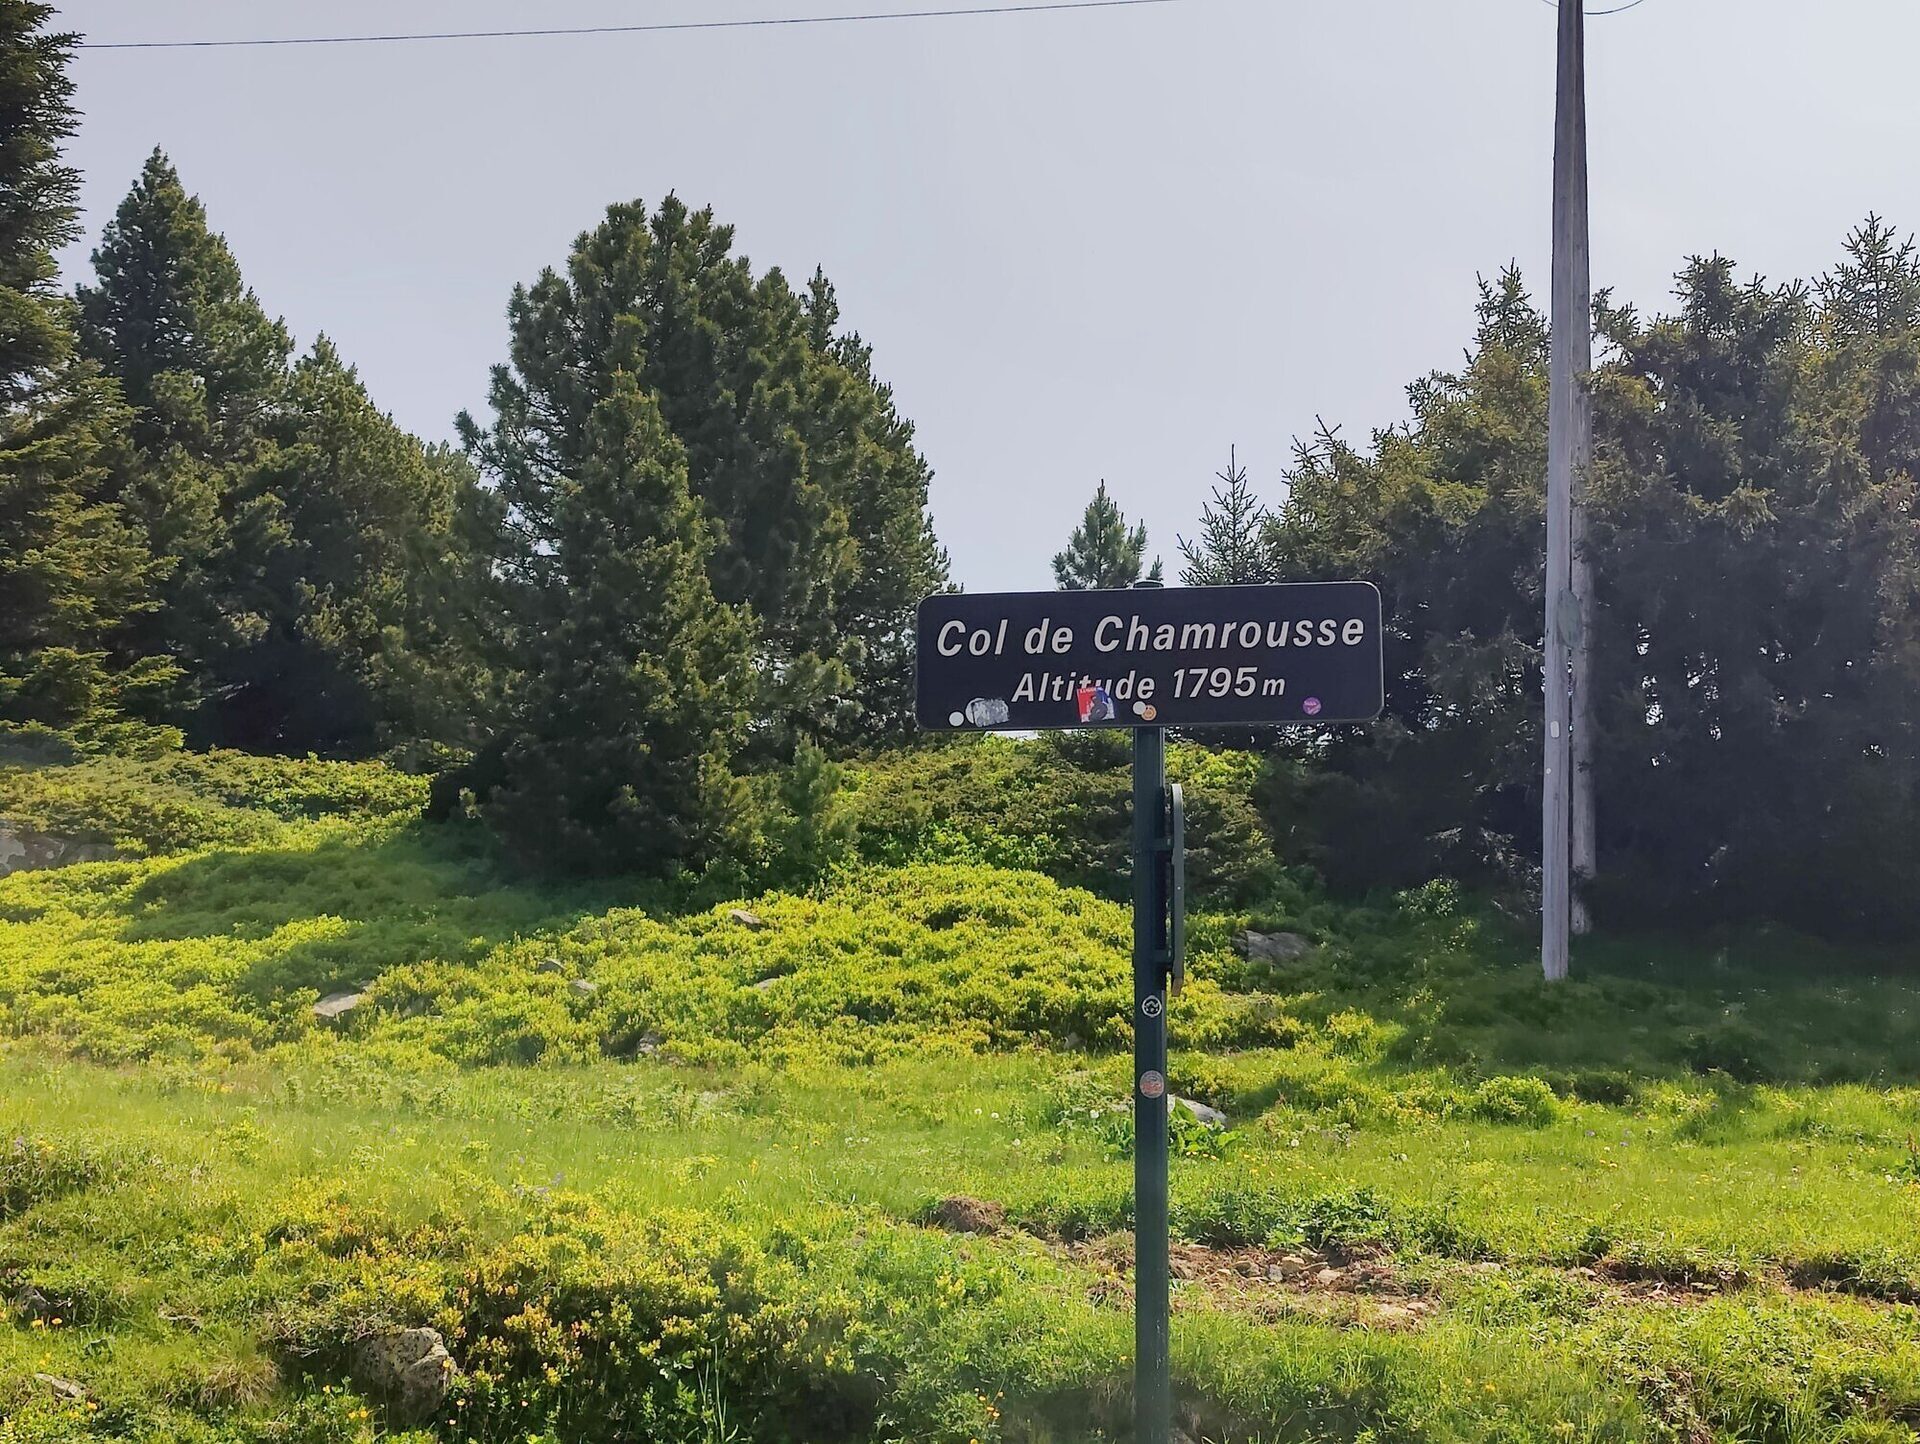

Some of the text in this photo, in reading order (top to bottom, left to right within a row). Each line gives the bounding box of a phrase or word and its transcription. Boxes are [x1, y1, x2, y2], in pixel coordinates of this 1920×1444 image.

[937, 614, 1364, 657] Col de Chamrousse
